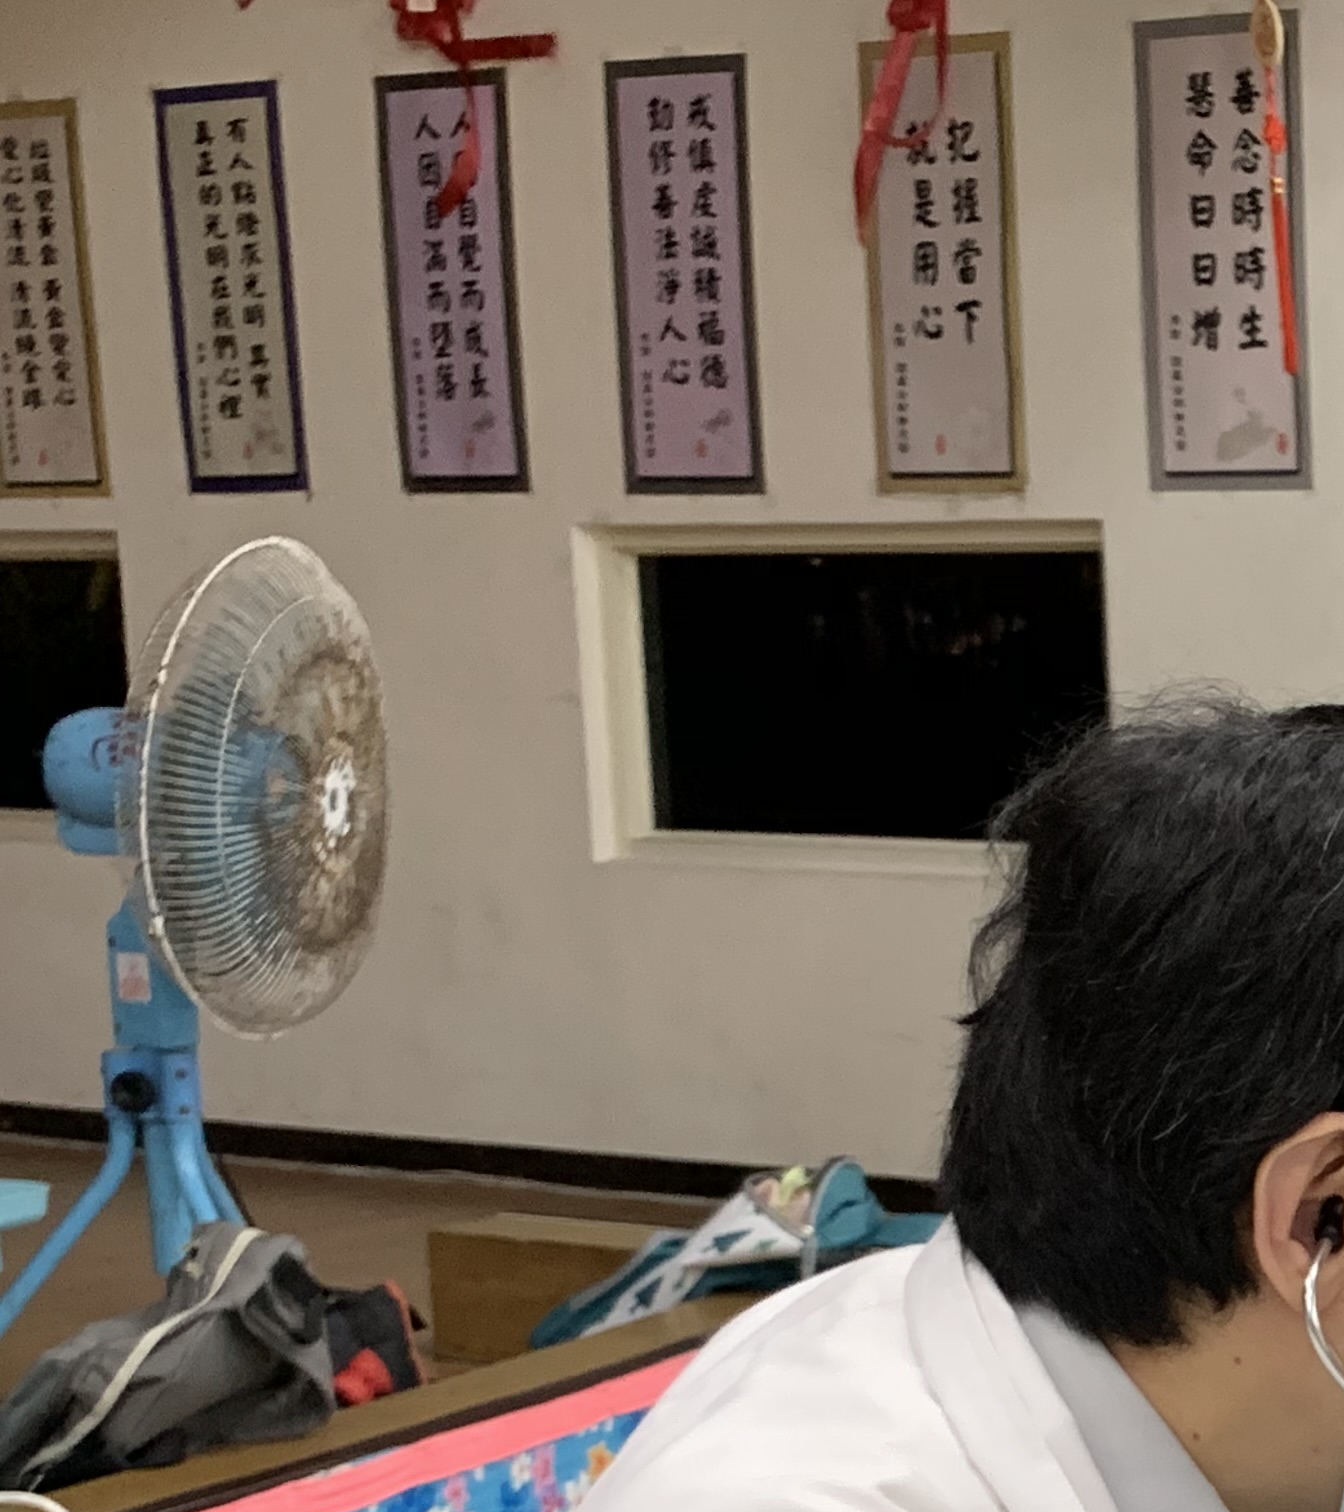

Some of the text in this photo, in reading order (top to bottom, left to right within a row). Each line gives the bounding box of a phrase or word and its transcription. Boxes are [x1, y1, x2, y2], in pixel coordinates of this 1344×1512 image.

[947, 117, 983, 345] 把握當下
[1229, 66, 1268, 350] 善念時時生
